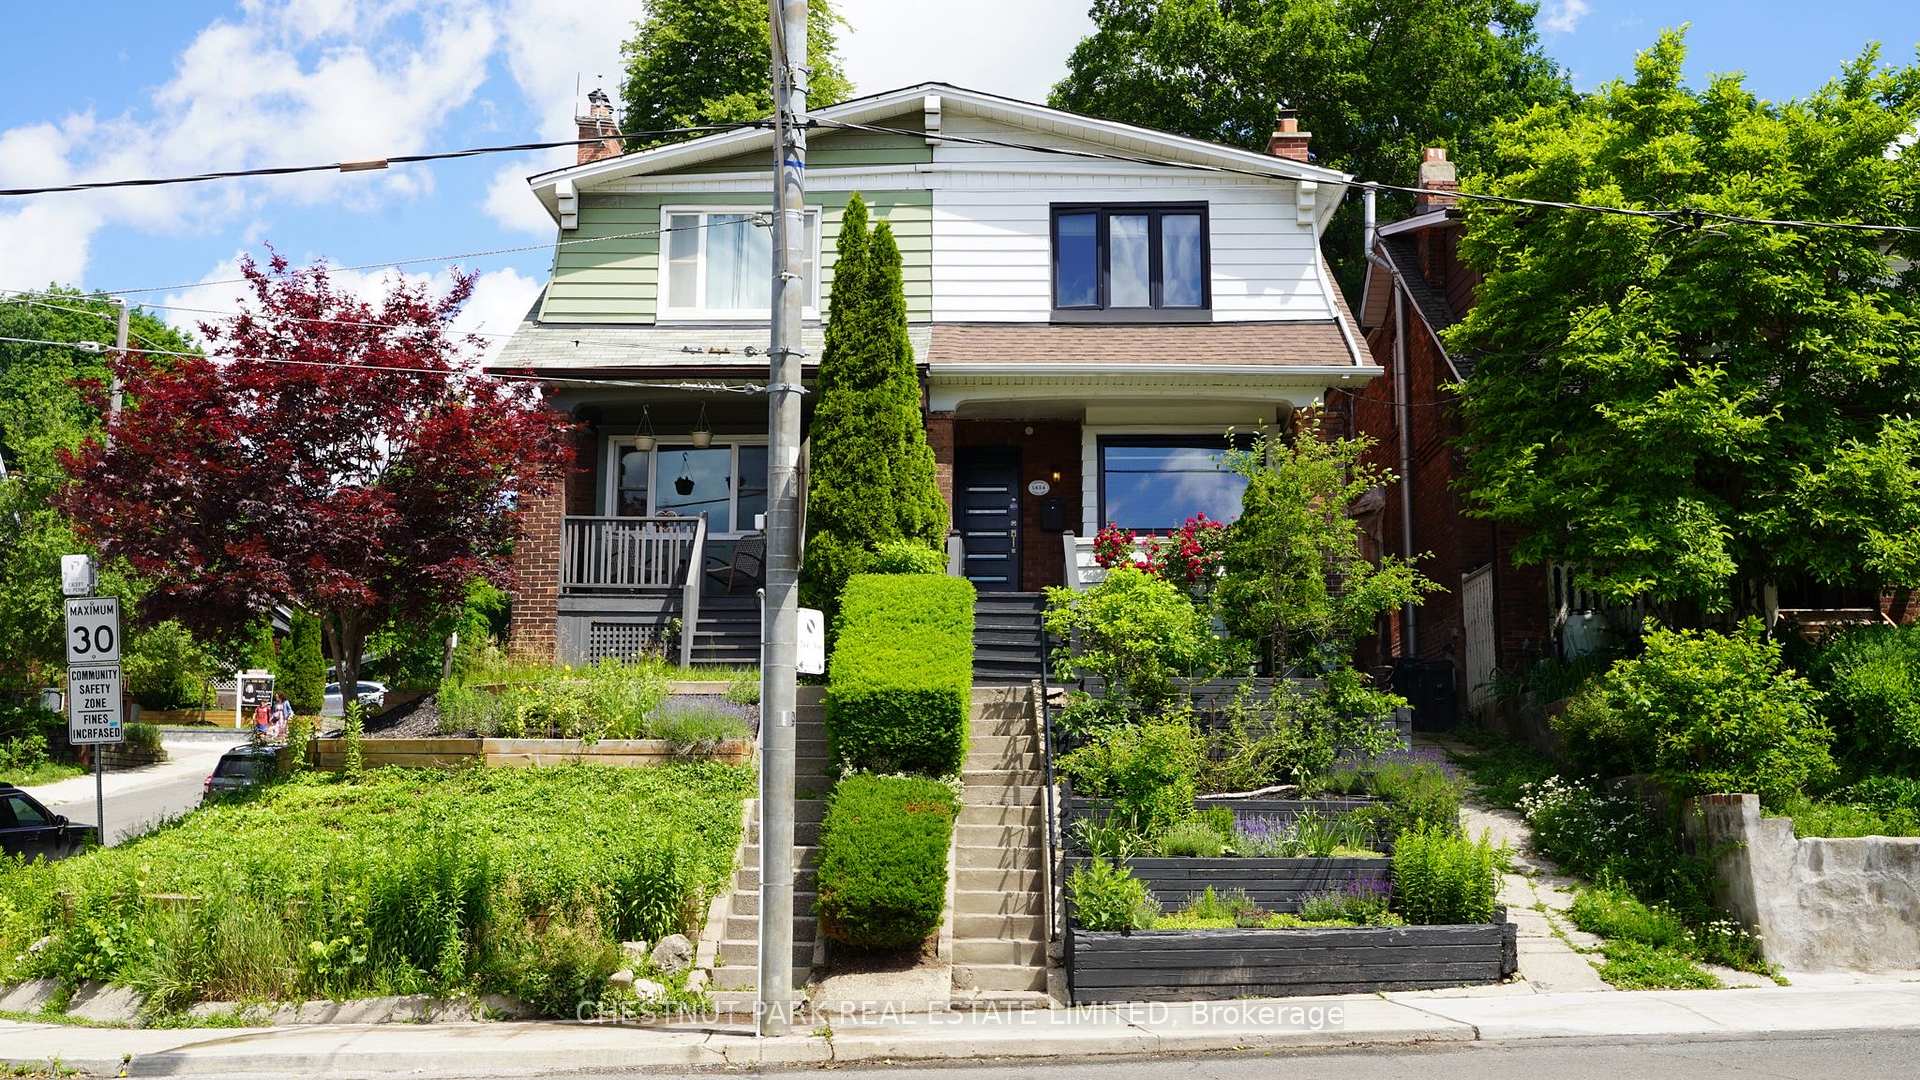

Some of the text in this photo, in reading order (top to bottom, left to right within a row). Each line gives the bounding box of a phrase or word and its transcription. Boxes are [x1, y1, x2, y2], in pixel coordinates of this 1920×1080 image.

[70, 604, 114, 617] MAXIMUM
[73, 625, 114, 654] 30
[71, 670, 118, 681] COMMUNITY
[79, 683, 111, 695] SAFETY
[84, 698, 107, 709] ZONE
[83, 713, 109, 725] FINES
